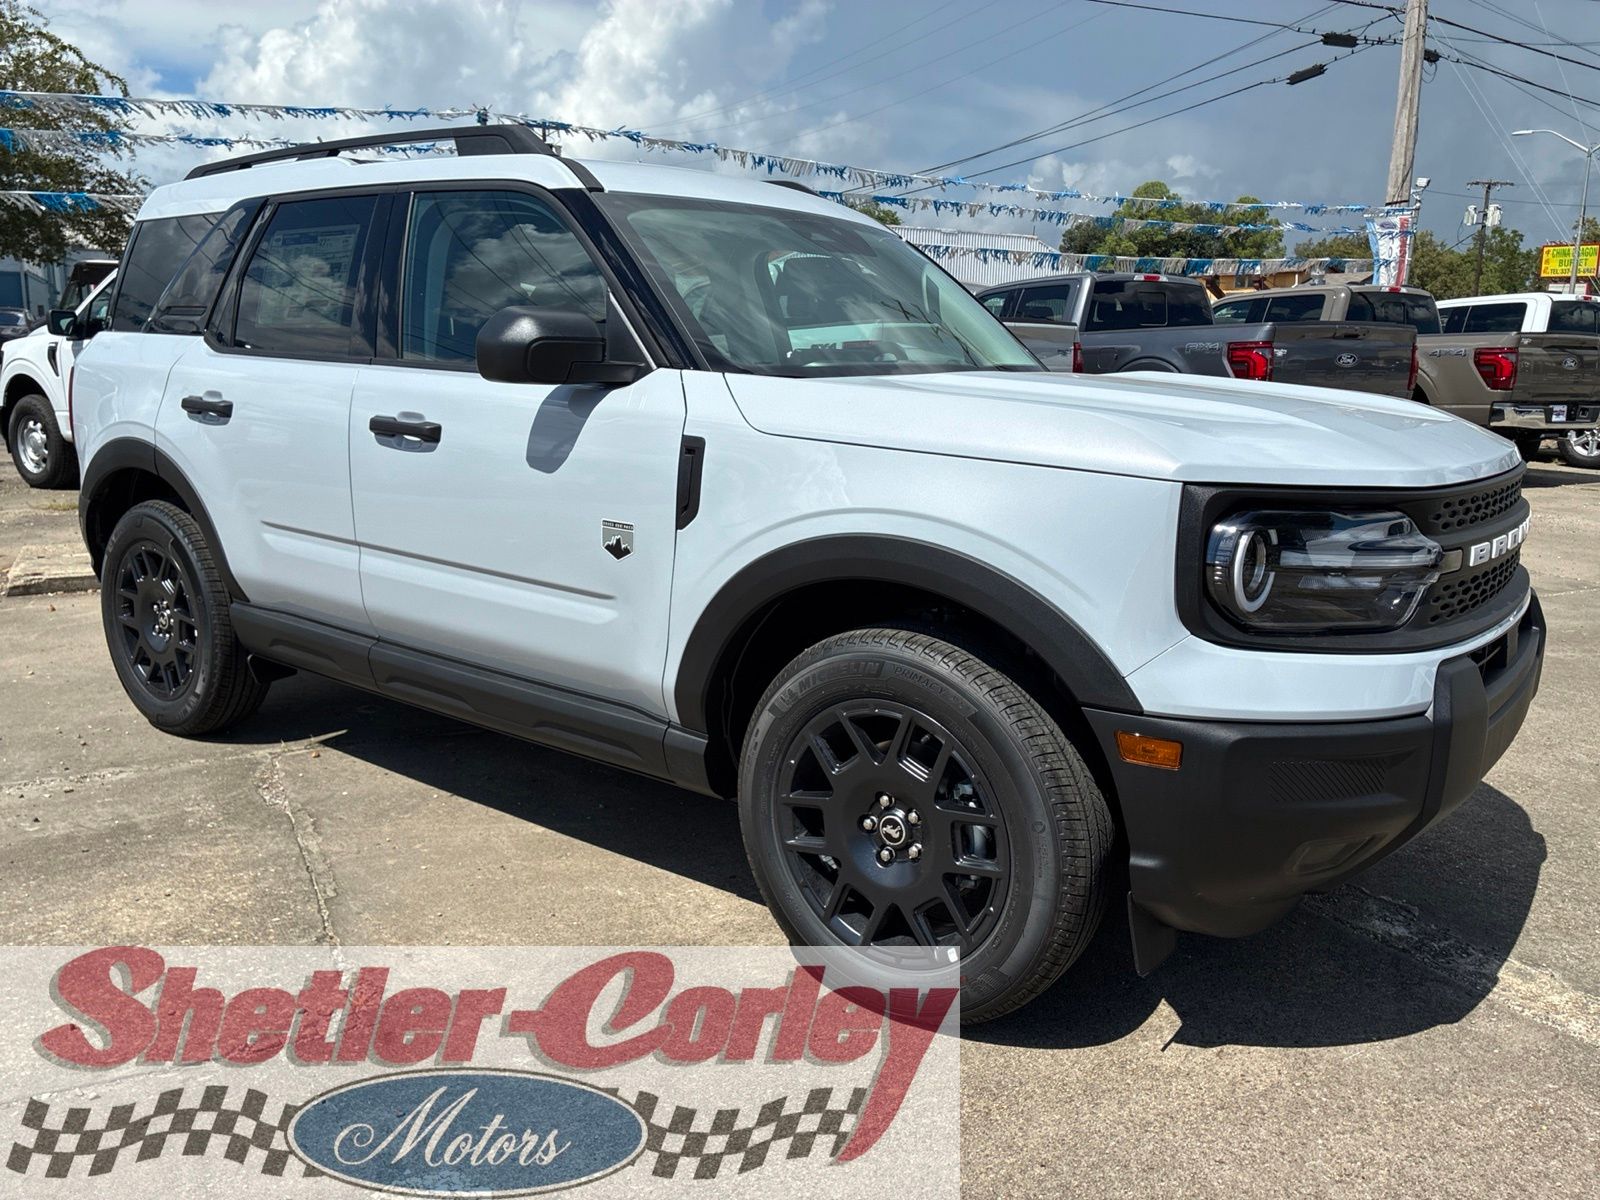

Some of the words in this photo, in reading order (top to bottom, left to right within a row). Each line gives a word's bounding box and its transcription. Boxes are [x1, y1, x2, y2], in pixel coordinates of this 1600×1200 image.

[1552, 249, 1571, 258] CHINA
[1573, 246, 1598, 257] DAGON
[1559, 258, 1588, 267] BUFET
[1469, 511, 1532, 567] BRON
[894, 664, 947, 695] PRIMACY
